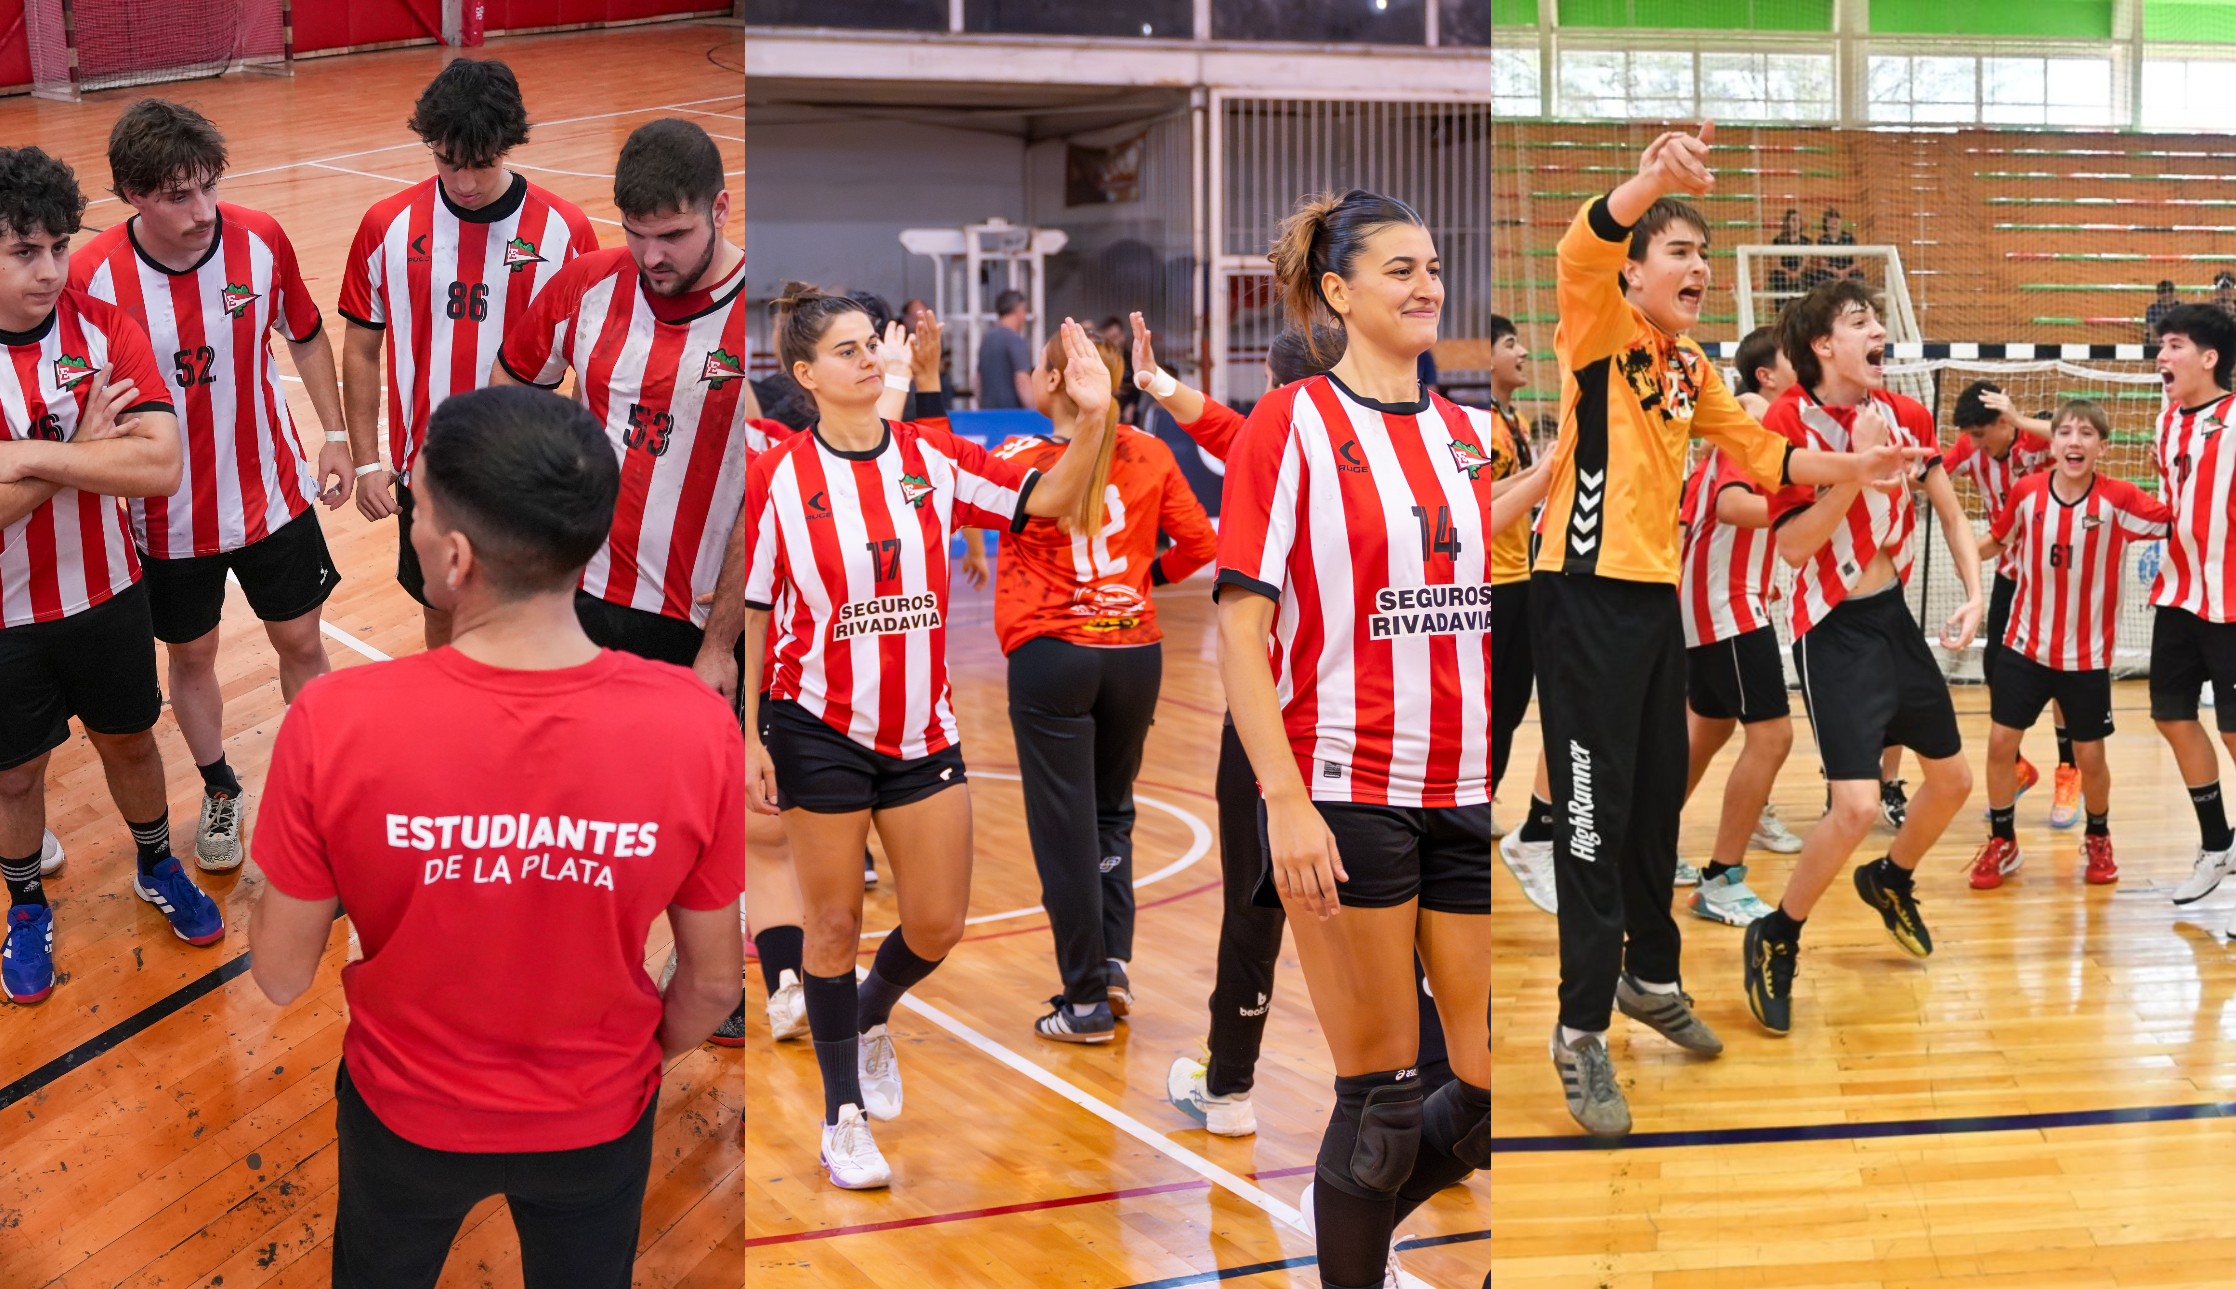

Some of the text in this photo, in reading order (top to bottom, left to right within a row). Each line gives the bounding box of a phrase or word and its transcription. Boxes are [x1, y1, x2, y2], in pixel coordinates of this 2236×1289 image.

[446, 281, 490, 323] 86
[173, 345, 217, 388] 52
[622, 403, 675, 457] 53
[1411, 505, 1462, 562] 14
[865, 538, 902, 583] 17
[2049, 543, 2074, 570] 61
[841, 593, 935, 620] SEGUROS
[1379, 585, 1491, 611] SEGUROS
[835, 612, 940, 640] RIVADAVIA
[1567, 738, 1602, 862] HighRunner
[386, 813, 659, 858] ESTUDIANTES
[424, 853, 614, 891] DE LA PLATA
